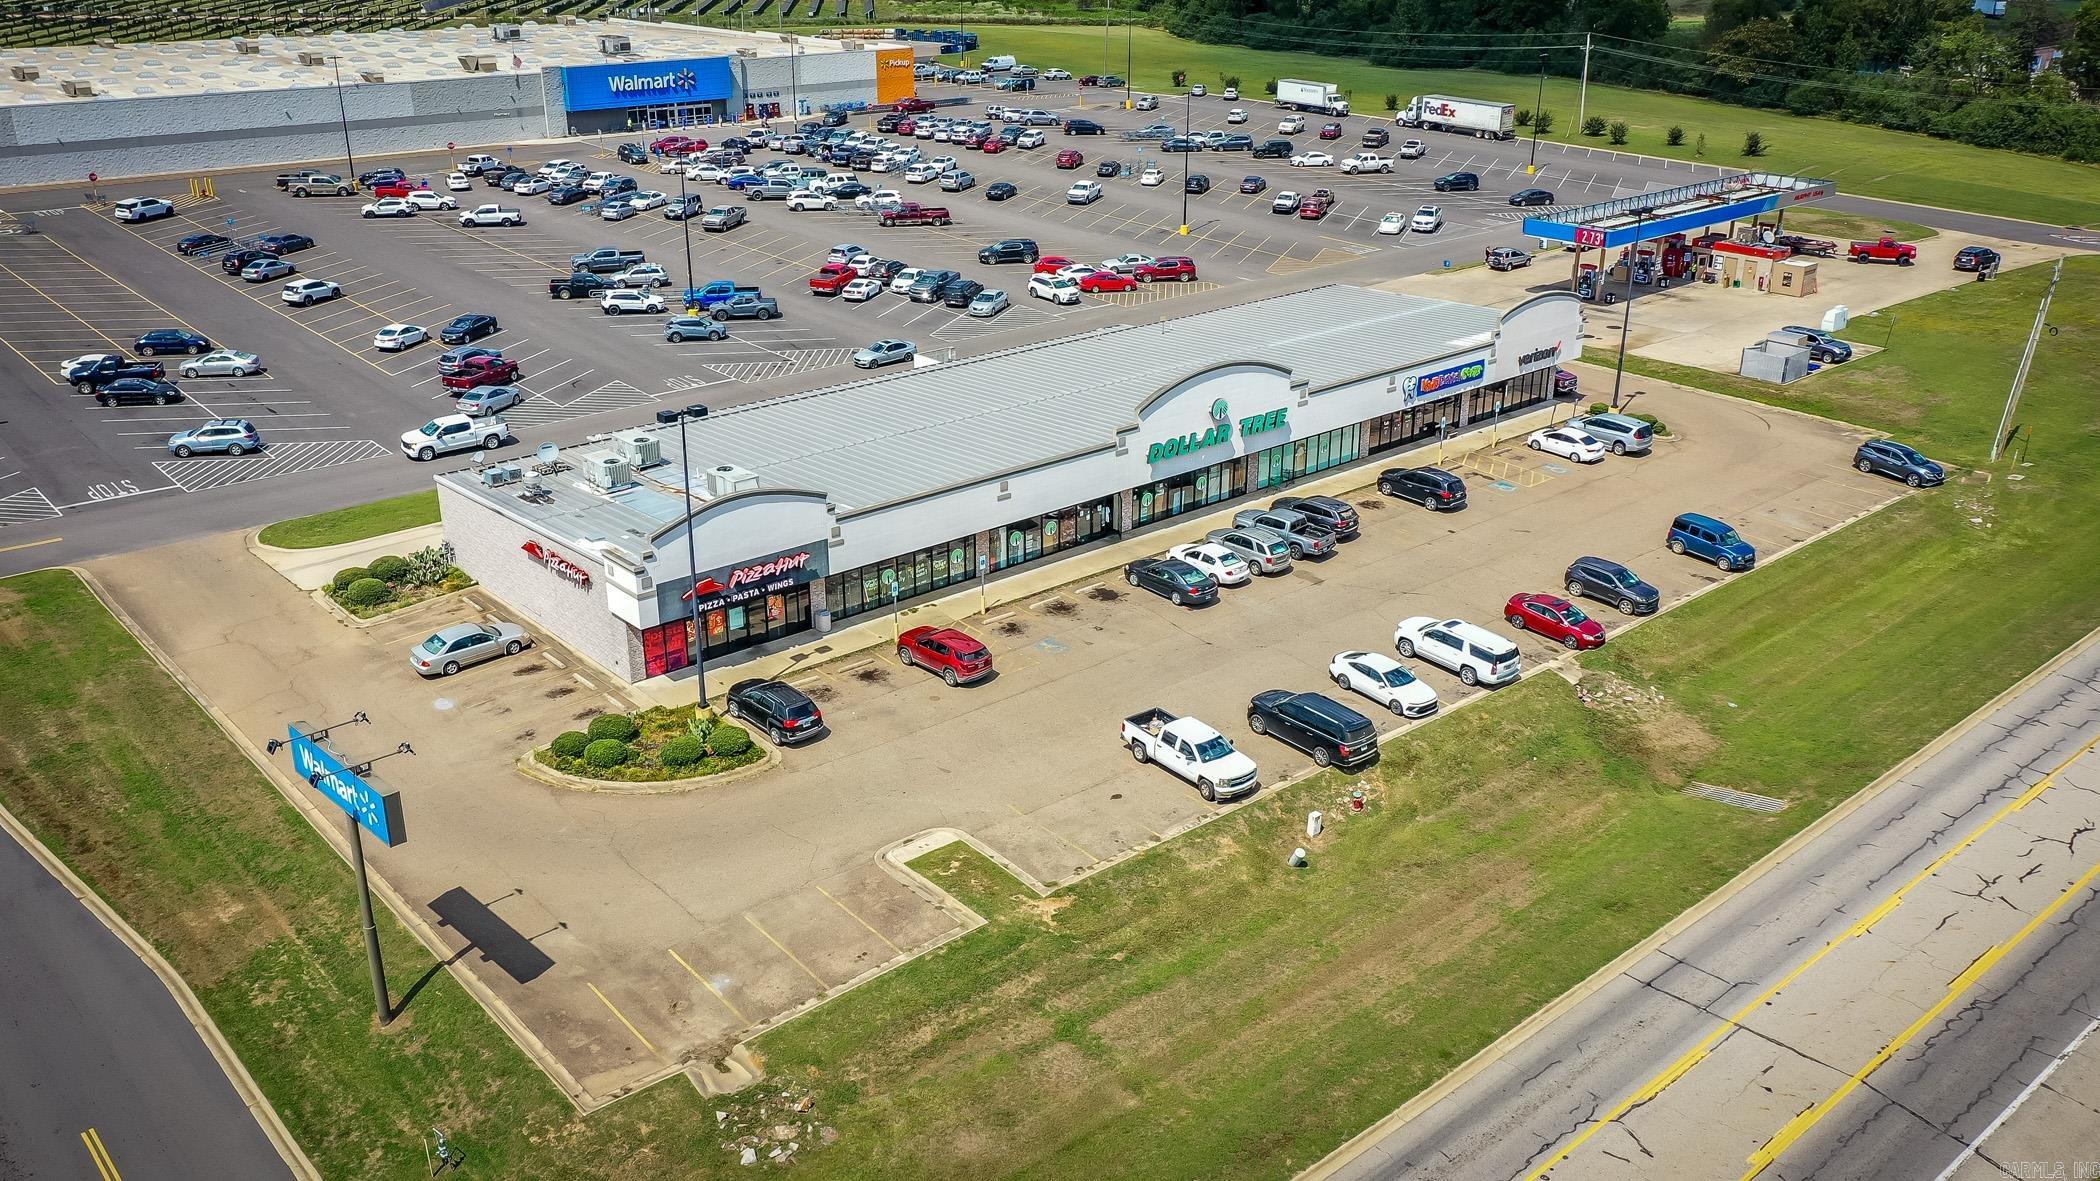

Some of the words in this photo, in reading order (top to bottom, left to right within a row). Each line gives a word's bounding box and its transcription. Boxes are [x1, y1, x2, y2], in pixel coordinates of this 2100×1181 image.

[890, 59, 910, 67] Pickup
[608, 72, 676, 92] Walmart
[1424, 101, 1456, 118] FedEx
[33, 208, 65, 217] STOP
[1518, 346, 1557, 367] verizon
[1147, 423, 1231, 464] DOLLAR
[1239, 407, 1288, 438] TREE
[87, 479, 140, 500] STOP
[699, 598, 725, 612] PIZZA
[732, 588, 760, 602] PASTA
[767, 578, 794, 592] WINGS
[299, 743, 360, 811] Walmart
